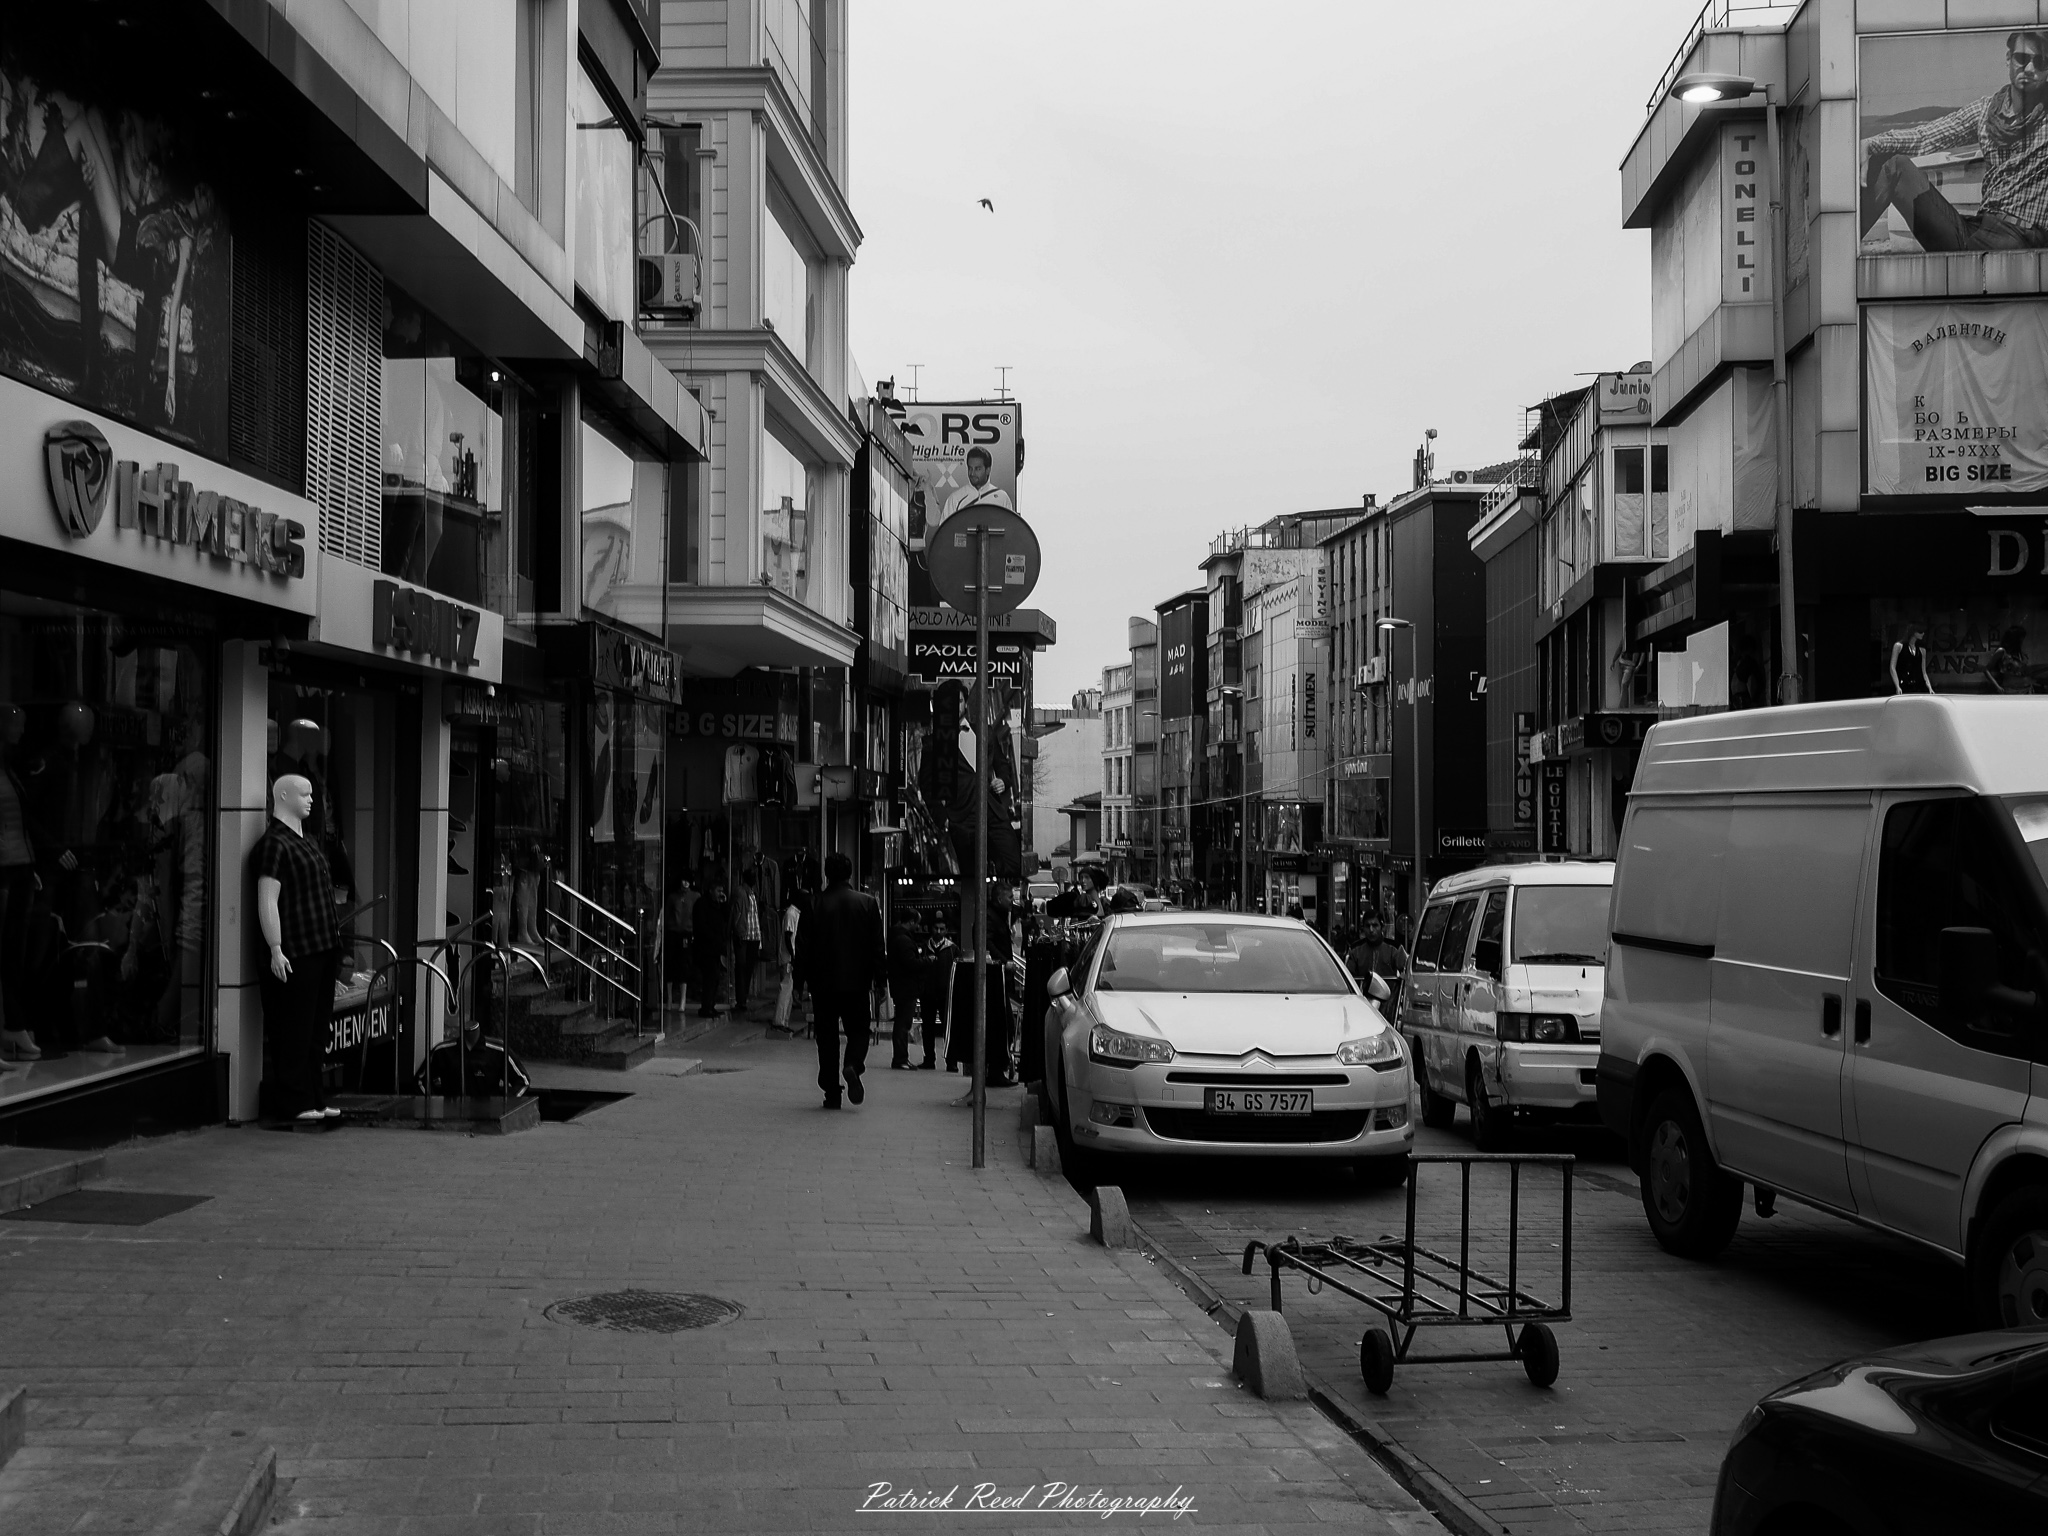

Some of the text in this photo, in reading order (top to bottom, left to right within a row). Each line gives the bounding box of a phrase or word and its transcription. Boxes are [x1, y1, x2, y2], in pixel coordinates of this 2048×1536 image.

[1912, 323, 2007, 352] ВАЛЕНТИН
[1610, 378, 1651, 396] Junio
[1914, 426, 2018, 442] РАЗМЕРЫ
[912, 445, 966, 459] High Life
[1925, 464, 2012, 482] BIG SIZE
[909, 612, 943, 626] AOLO
[1167, 643, 1186, 662] MAD
[721, 713, 774, 738] SIZE
[1517, 714, 1532, 820] LEXUS
[1546, 766, 1564, 778] LE
[1216, 1093, 1309, 1111] 34 GS 7577
